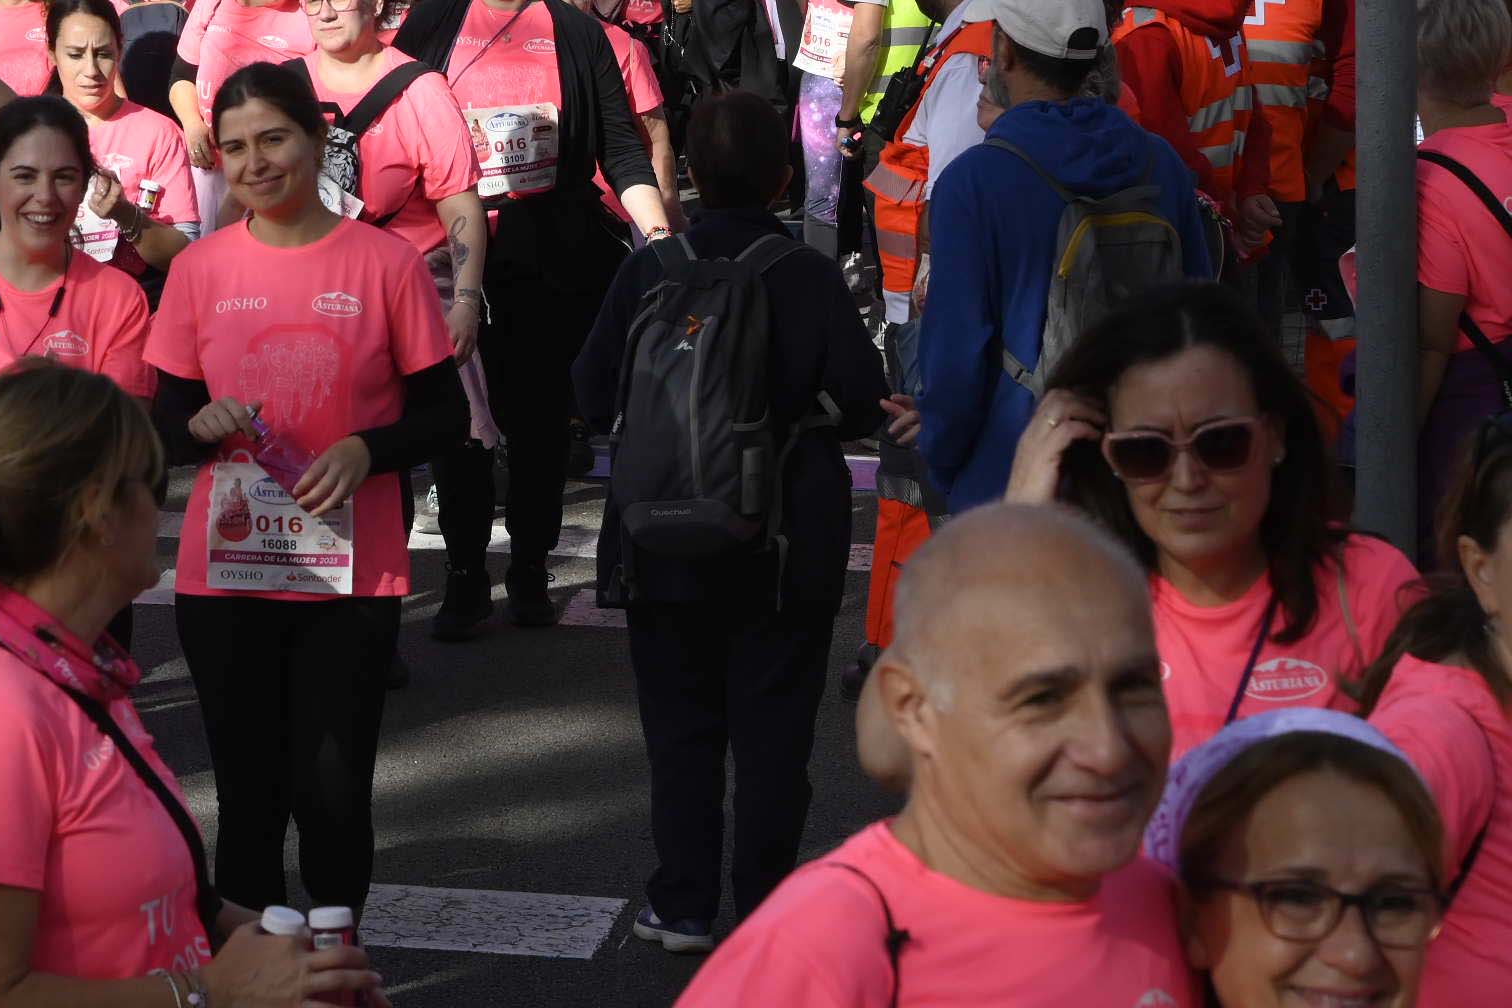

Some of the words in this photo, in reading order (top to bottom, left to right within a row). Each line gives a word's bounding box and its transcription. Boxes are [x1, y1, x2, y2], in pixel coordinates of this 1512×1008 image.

[494, 137, 527, 153] 016
[215, 296, 268, 314] OYSHO
[315, 299, 359, 314] ASTURIANA
[255, 514, 304, 534] 016
[261, 539, 297, 551] 16088
[224, 552, 263, 562] CARRERA
[288, 555, 317, 564] MUJER
[319, 556, 338, 565] 2023
[220, 569, 264, 582] OYSHO
[297, 572, 342, 584] Santander
